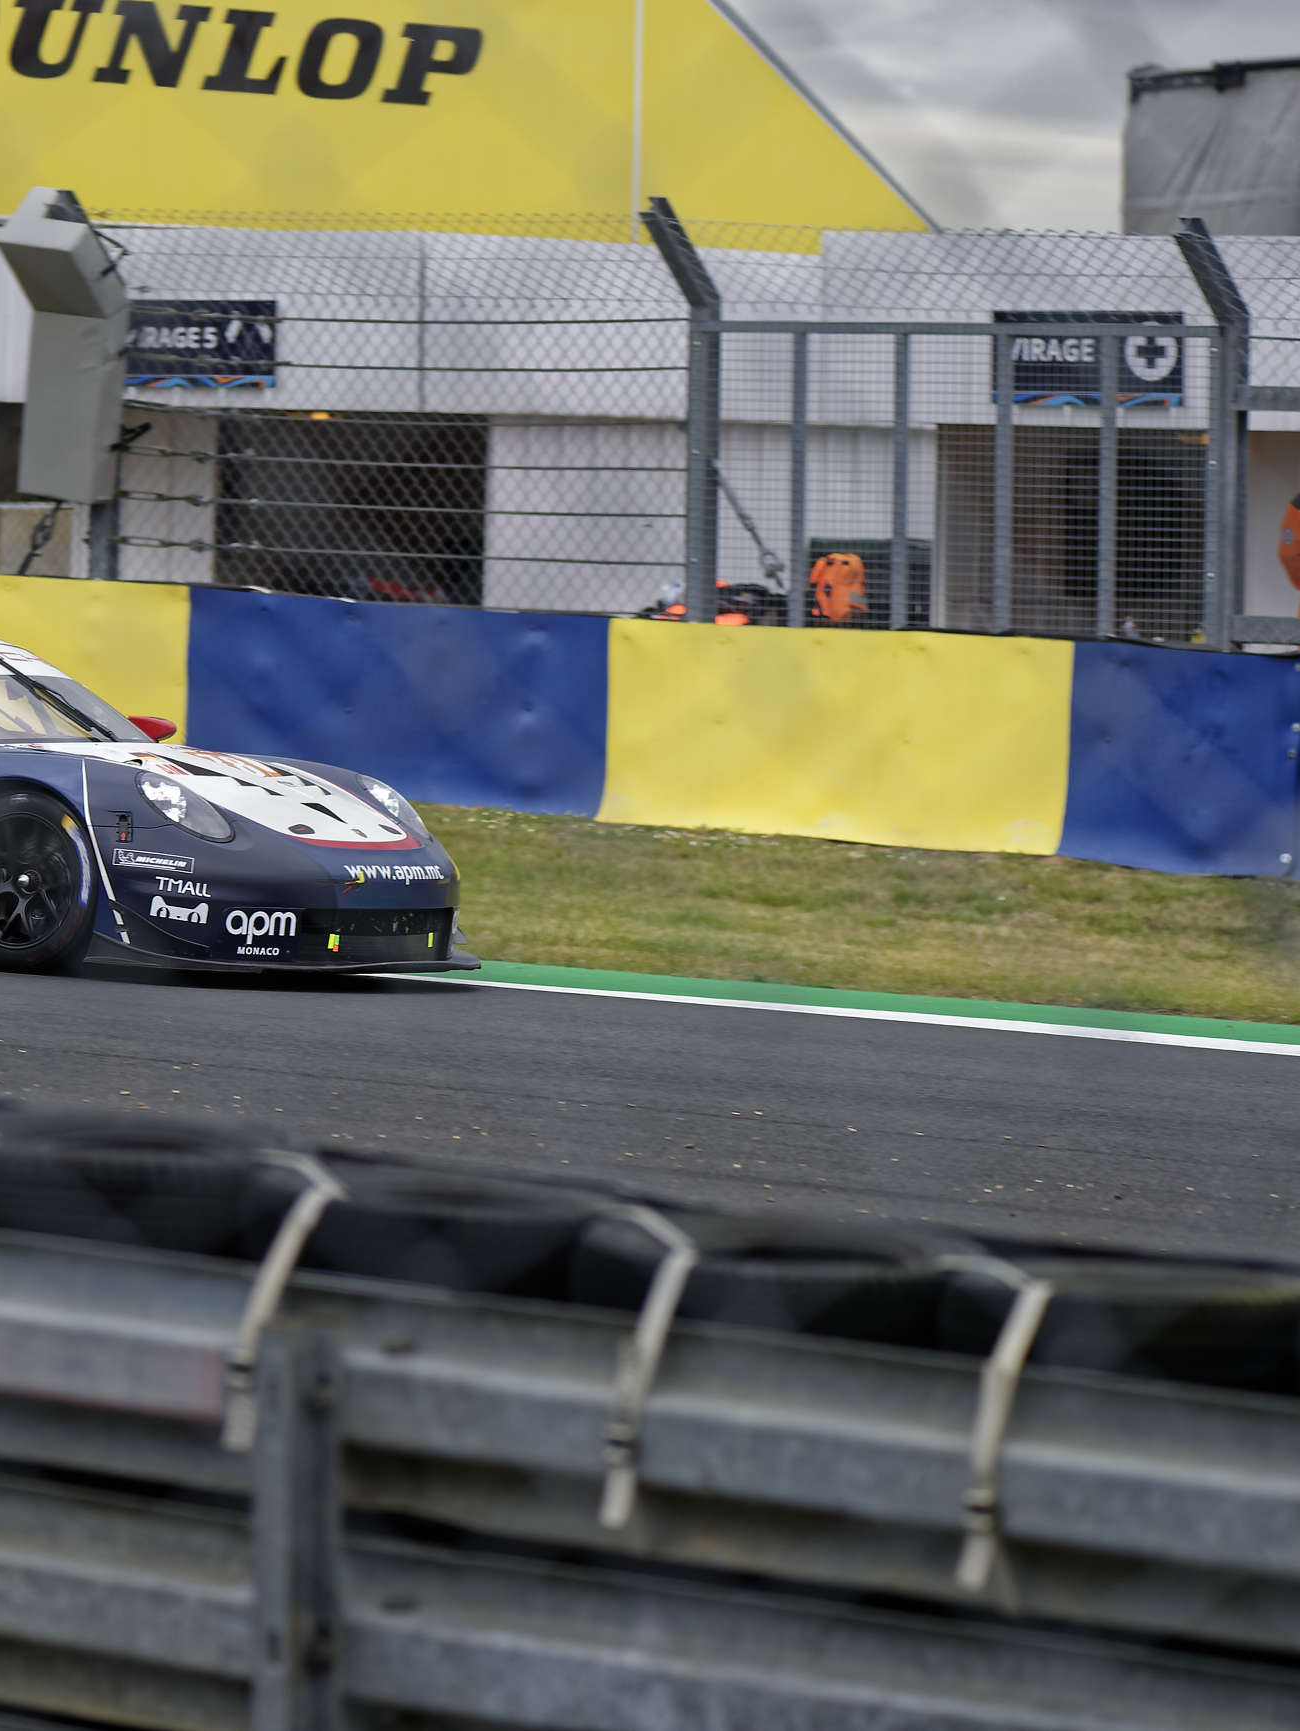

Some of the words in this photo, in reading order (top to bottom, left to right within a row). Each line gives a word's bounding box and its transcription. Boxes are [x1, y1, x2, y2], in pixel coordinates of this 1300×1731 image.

[135, 855, 187, 868] MICHELIN
[156, 876, 211, 898] TMALL
[225, 910, 297, 945] apm
[236, 946, 280, 956] MONACO
